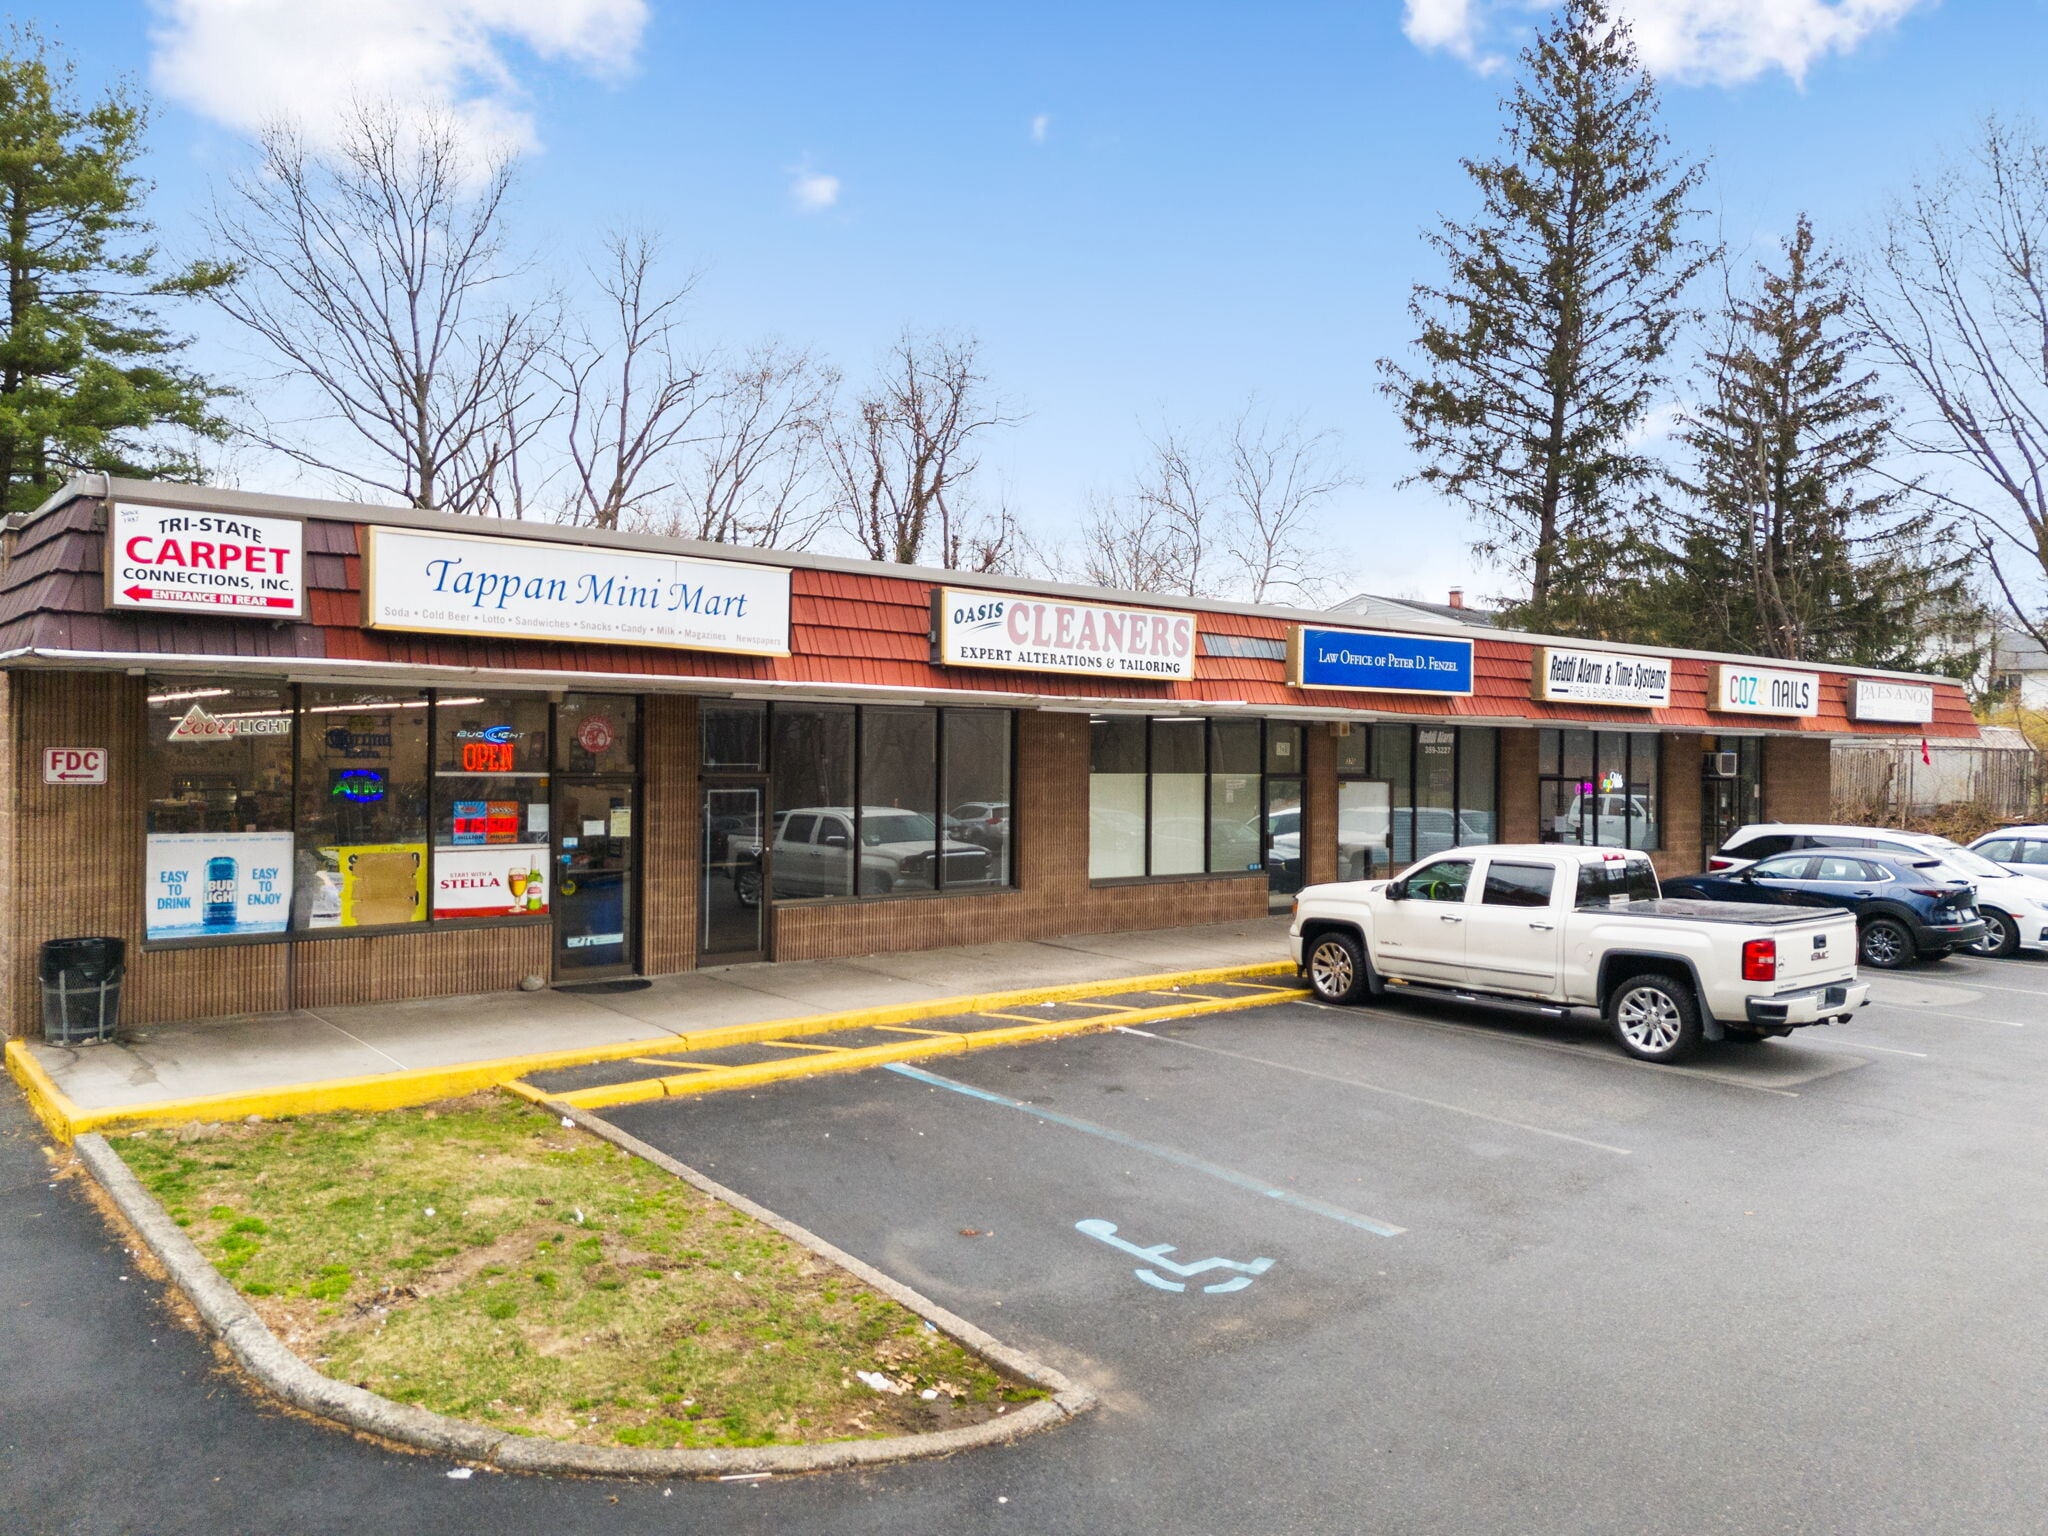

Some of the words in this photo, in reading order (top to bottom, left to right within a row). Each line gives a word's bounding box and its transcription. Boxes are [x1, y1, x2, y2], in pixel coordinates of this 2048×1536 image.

[159, 517, 262, 544] TRI-STATE
[126, 536, 290, 574] CARPET
[123, 567, 254, 590] CONNECTIONS,
[261, 578, 293, 591] INC.
[425, 557, 568, 609] Tappan
[575, 572, 662, 610] Mini
[667, 583, 748, 618] Mart
[152, 590, 216, 603] ENTRANCE
[220, 593, 232, 605] IN
[236, 594, 267, 606] REAR
[384, 606, 410, 617] Soda
[422, 608, 444, 620] Cold
[448, 611, 470, 622] Beer
[482, 613, 505, 624] Lotto
[515, 616, 570, 628] Sandwiches
[580, 620, 612, 632] Snacks
[621, 623, 647, 635] Candy
[656, 625, 675, 636] Milk
[684, 628, 727, 641] Magazines
[736, 633, 781, 646] Newspapers
[954, 602, 1004, 625] OASIS
[1007, 602, 1190, 658] CLEANERS
[960, 646, 1012, 662] EXPERT
[1018, 651, 1102, 668] ALTERATIONS
[1106, 657, 1115, 669] &
[1120, 659, 1180, 674] TAILORING
[1416, 655, 1427, 669] D.
[1550, 655, 1577, 681] Reddi
[1577, 658, 1602, 684] Alarm
[1605, 664, 1612, 685] &
[1614, 661, 1633, 687] Time
[1634, 663, 1667, 690] Systems
[1569, 685, 1585, 695] FIRE
[1593, 687, 1623, 699] BURGLAR
[1625, 690, 1649, 701] ALARMS
[1730, 674, 1766, 705] COZY
[1772, 679, 1809, 709] NAILS
[1861, 684, 1930, 705] PAESANOS
[177, 715, 238, 735] Coors
[239, 719, 292, 735] LIGHT
[51, 752, 99, 771] FDC
[463, 743, 514, 771] OPEN
[332, 779, 384, 795] ATM
[160, 871, 189, 883] EASY
[252, 868, 279, 880] EASY
[440, 878, 501, 889] STELLA
[168, 884, 182, 896] TO
[208, 880, 235, 891] BUD
[259, 881, 272, 892] TO
[157, 897, 191, 910] DRINK
[247, 893, 282, 905] ENJOY
